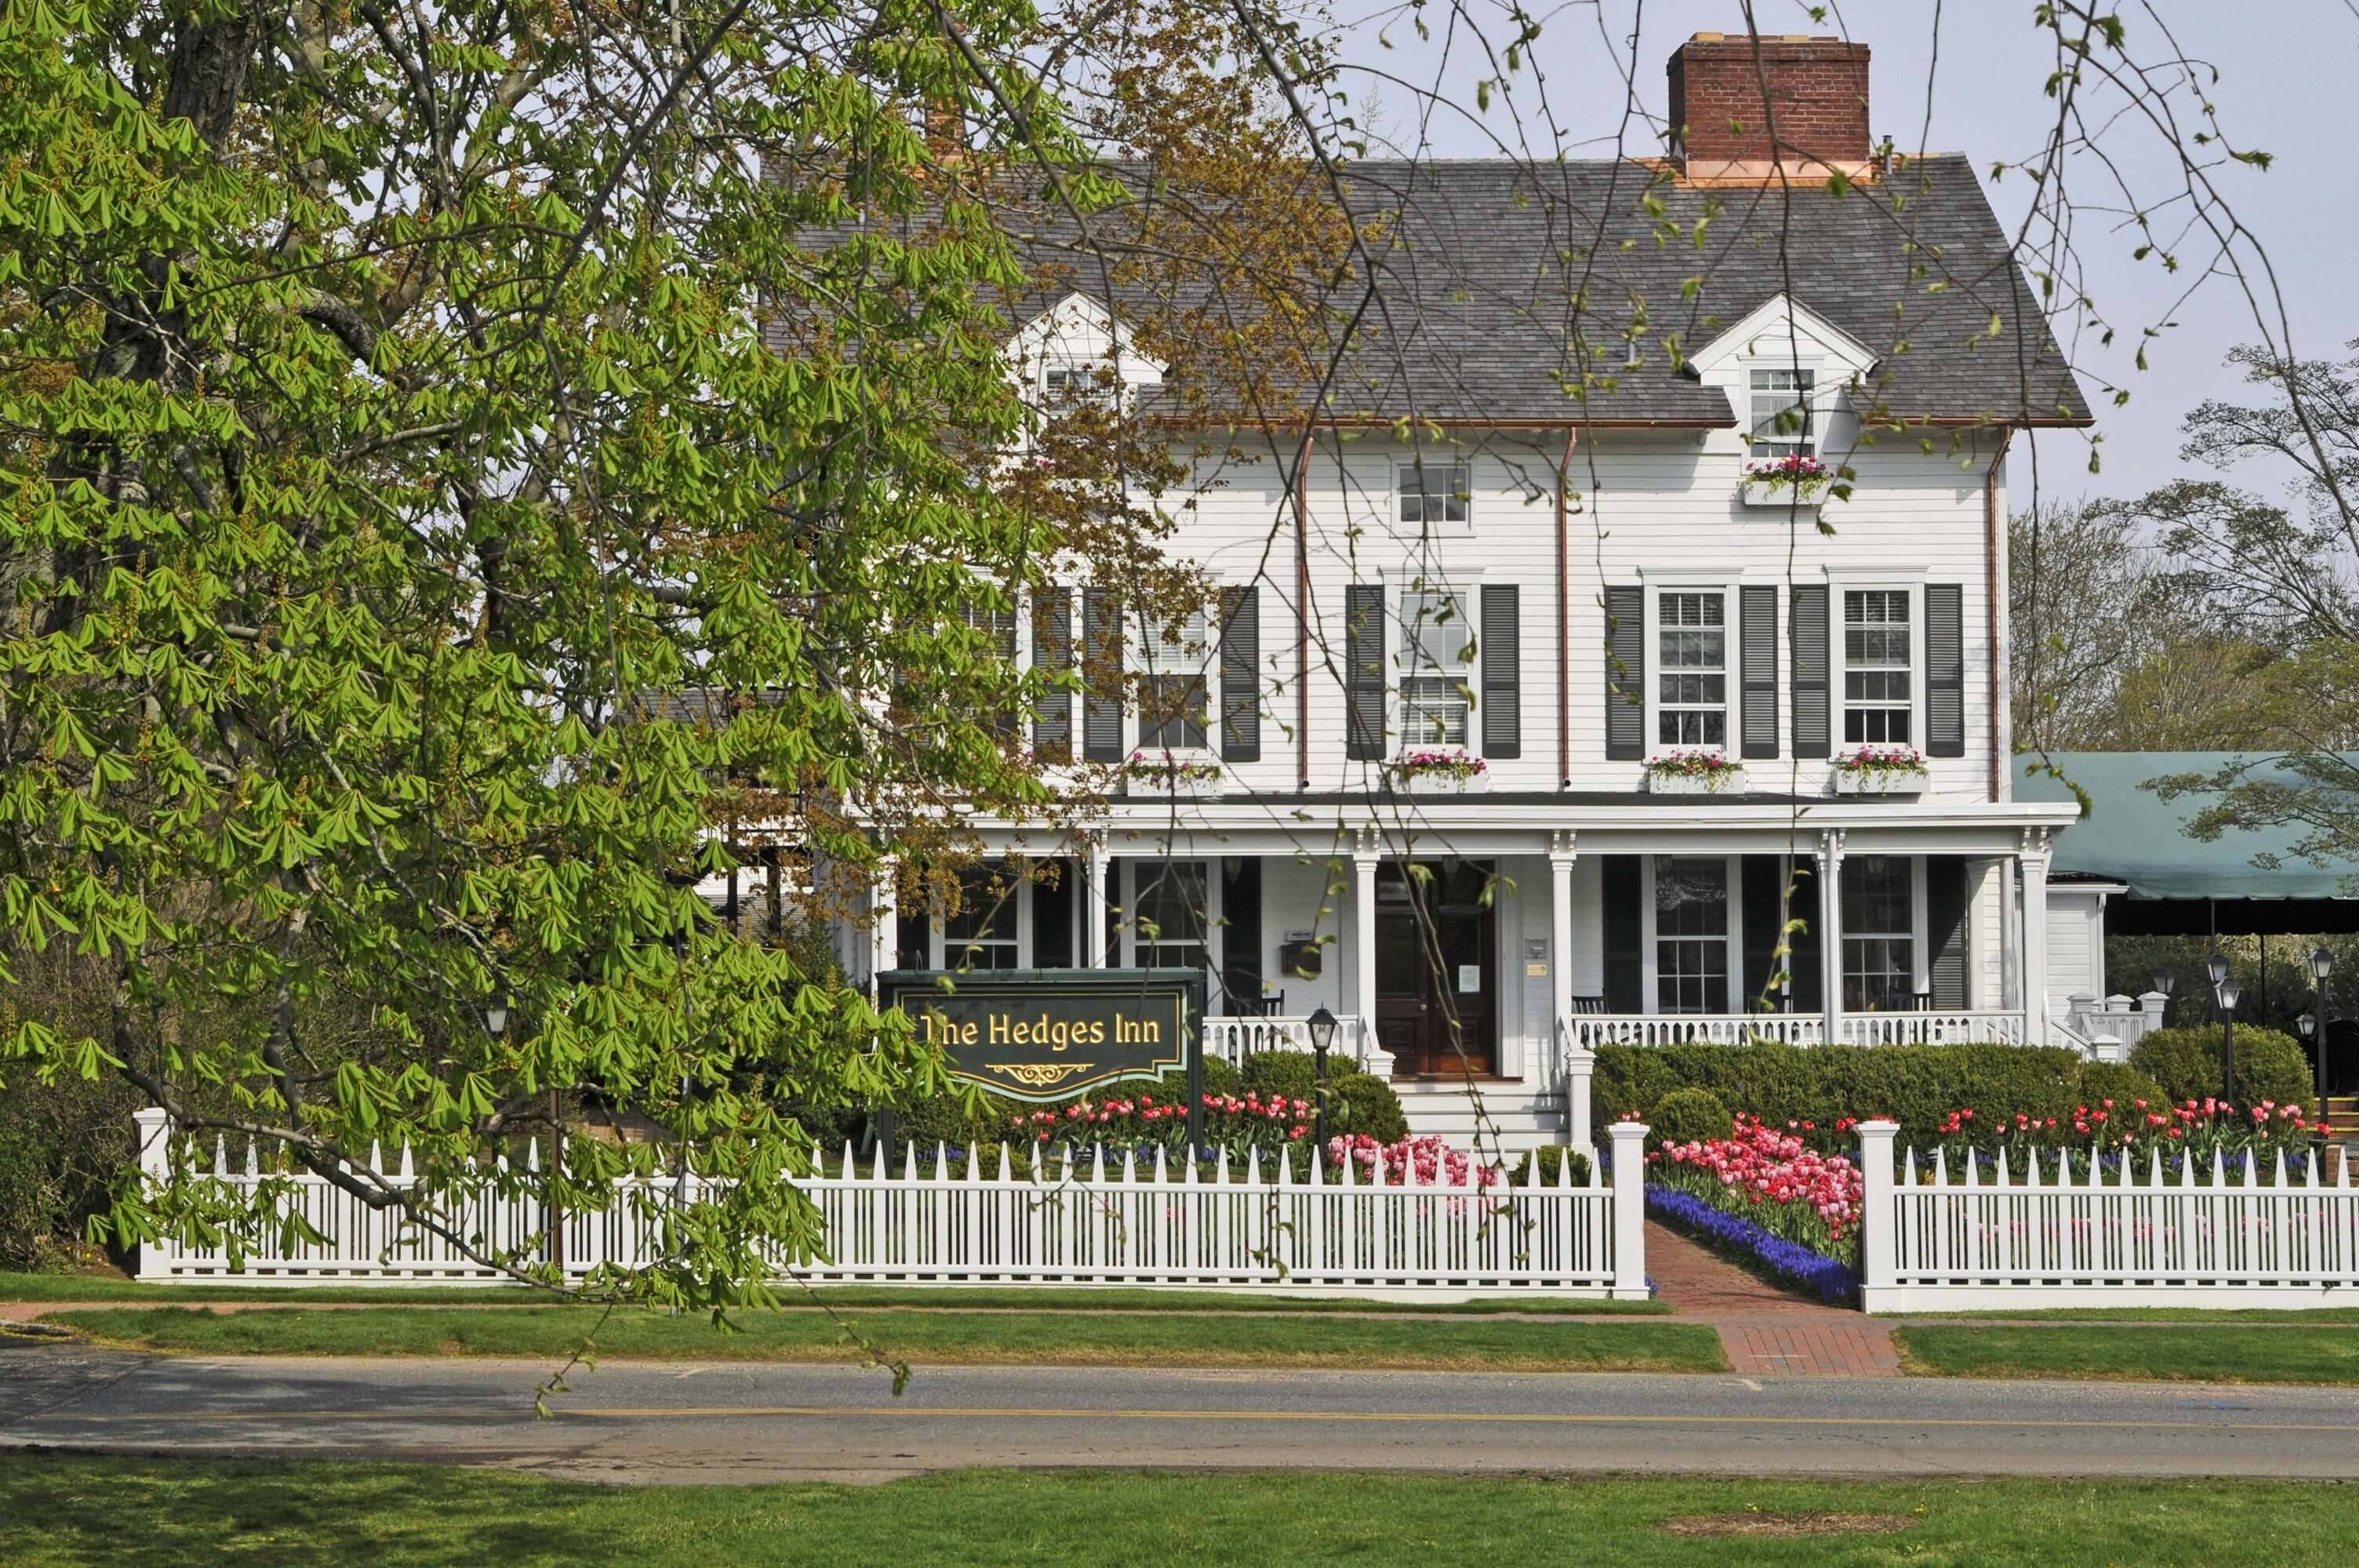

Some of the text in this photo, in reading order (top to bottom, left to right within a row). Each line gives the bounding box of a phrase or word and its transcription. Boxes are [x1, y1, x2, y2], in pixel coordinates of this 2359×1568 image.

[920, 1013, 1161, 1051] The Hedges Inn
